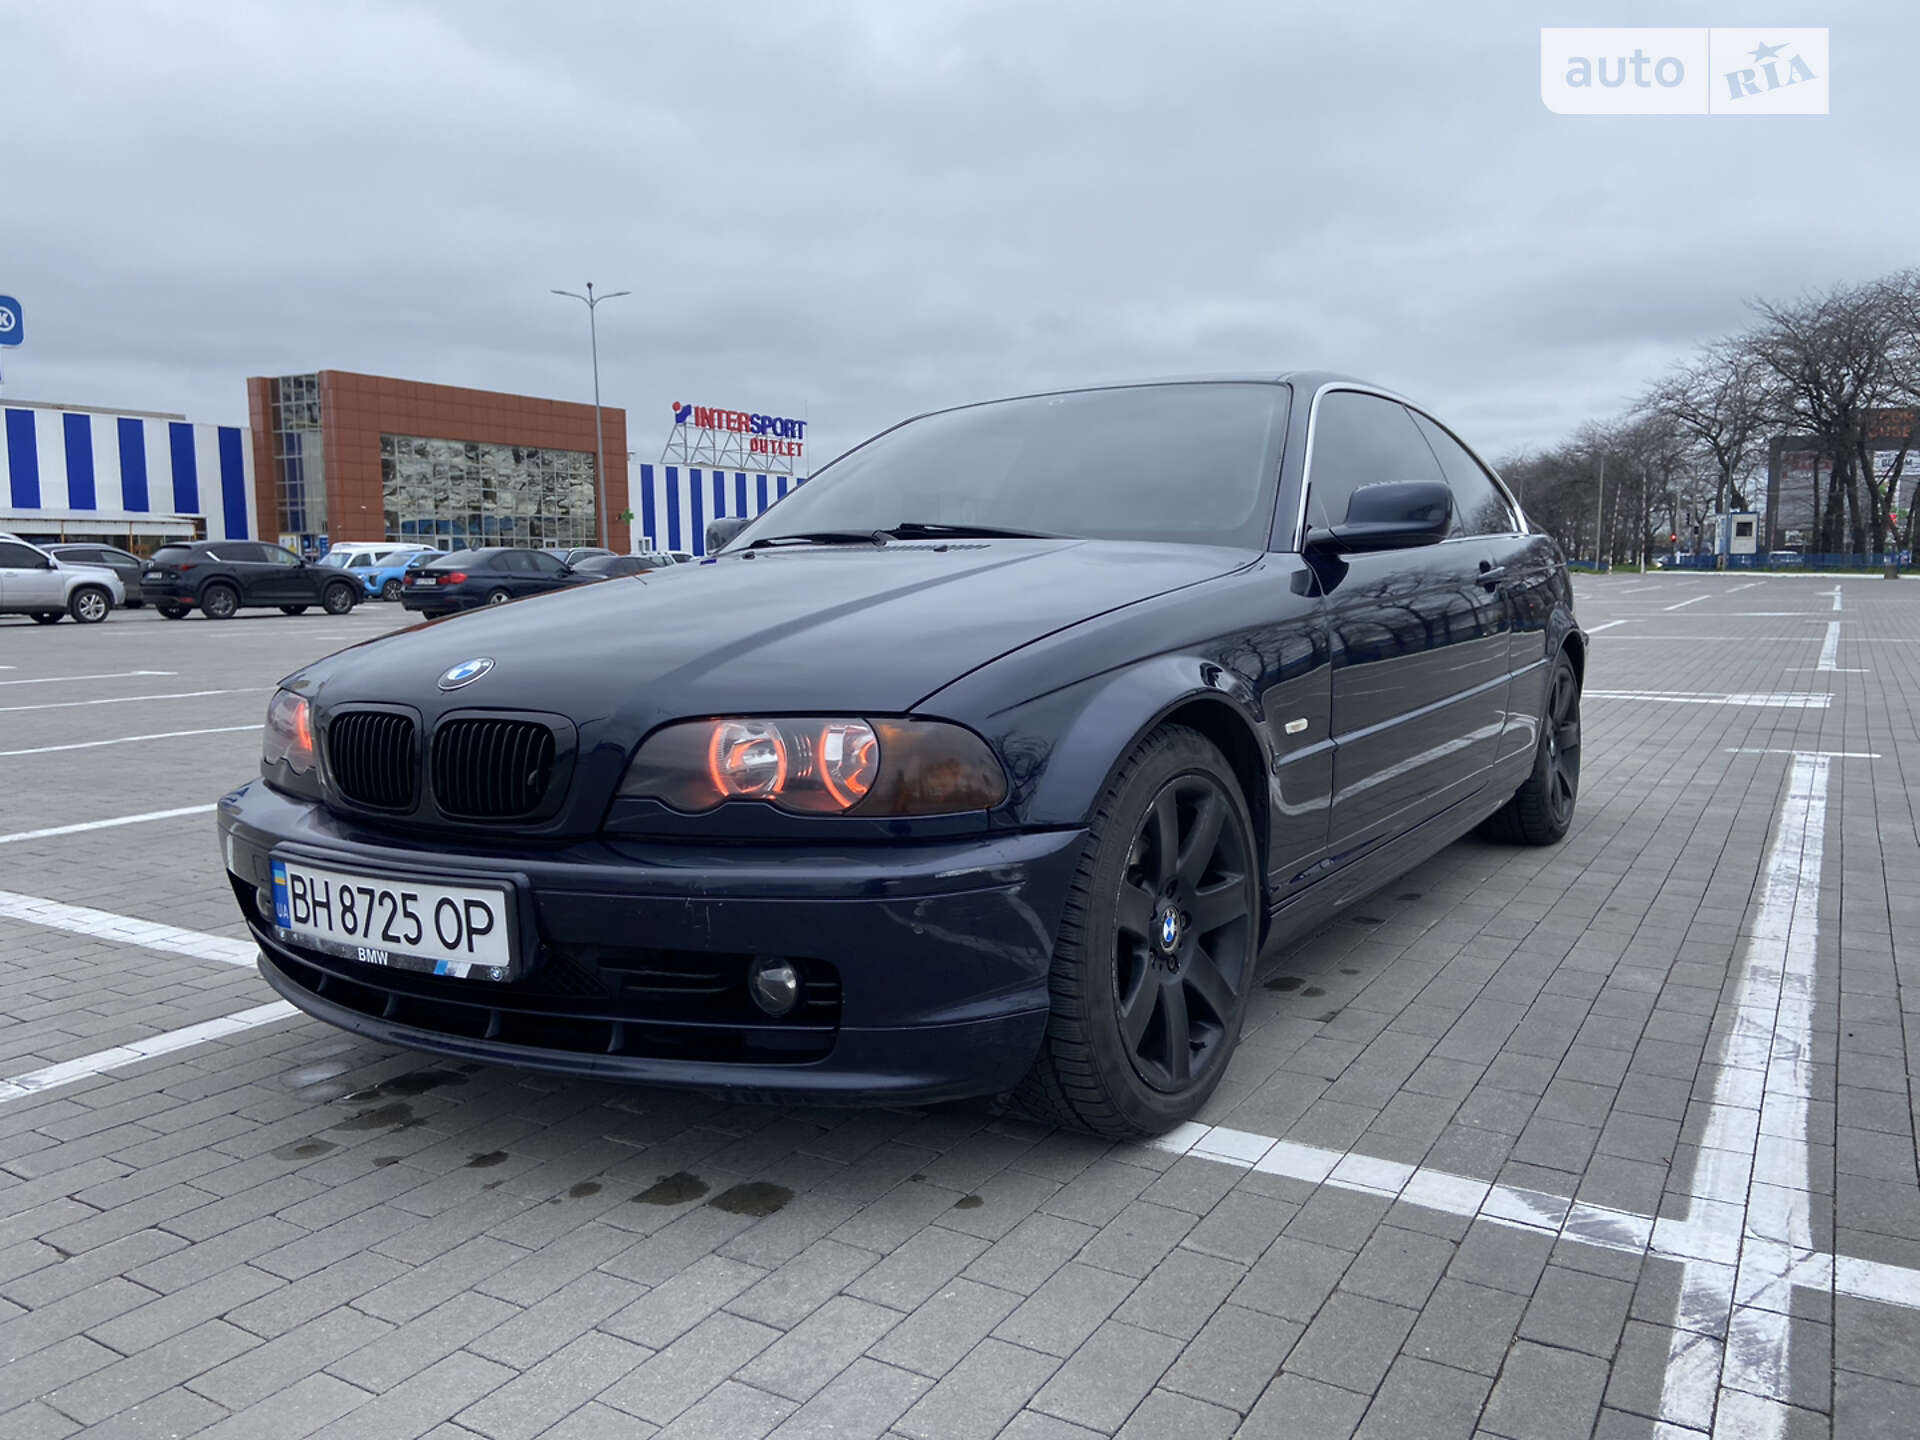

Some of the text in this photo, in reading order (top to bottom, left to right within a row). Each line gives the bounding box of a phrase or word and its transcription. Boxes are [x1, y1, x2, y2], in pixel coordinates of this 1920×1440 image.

[694, 406, 807, 440] INTERSPORT
[750, 437, 803, 457] OUTLET
[276, 902, 289, 920] UA
[289, 873, 495, 953] BH 8725 OP
[358, 947, 389, 966] BMW
